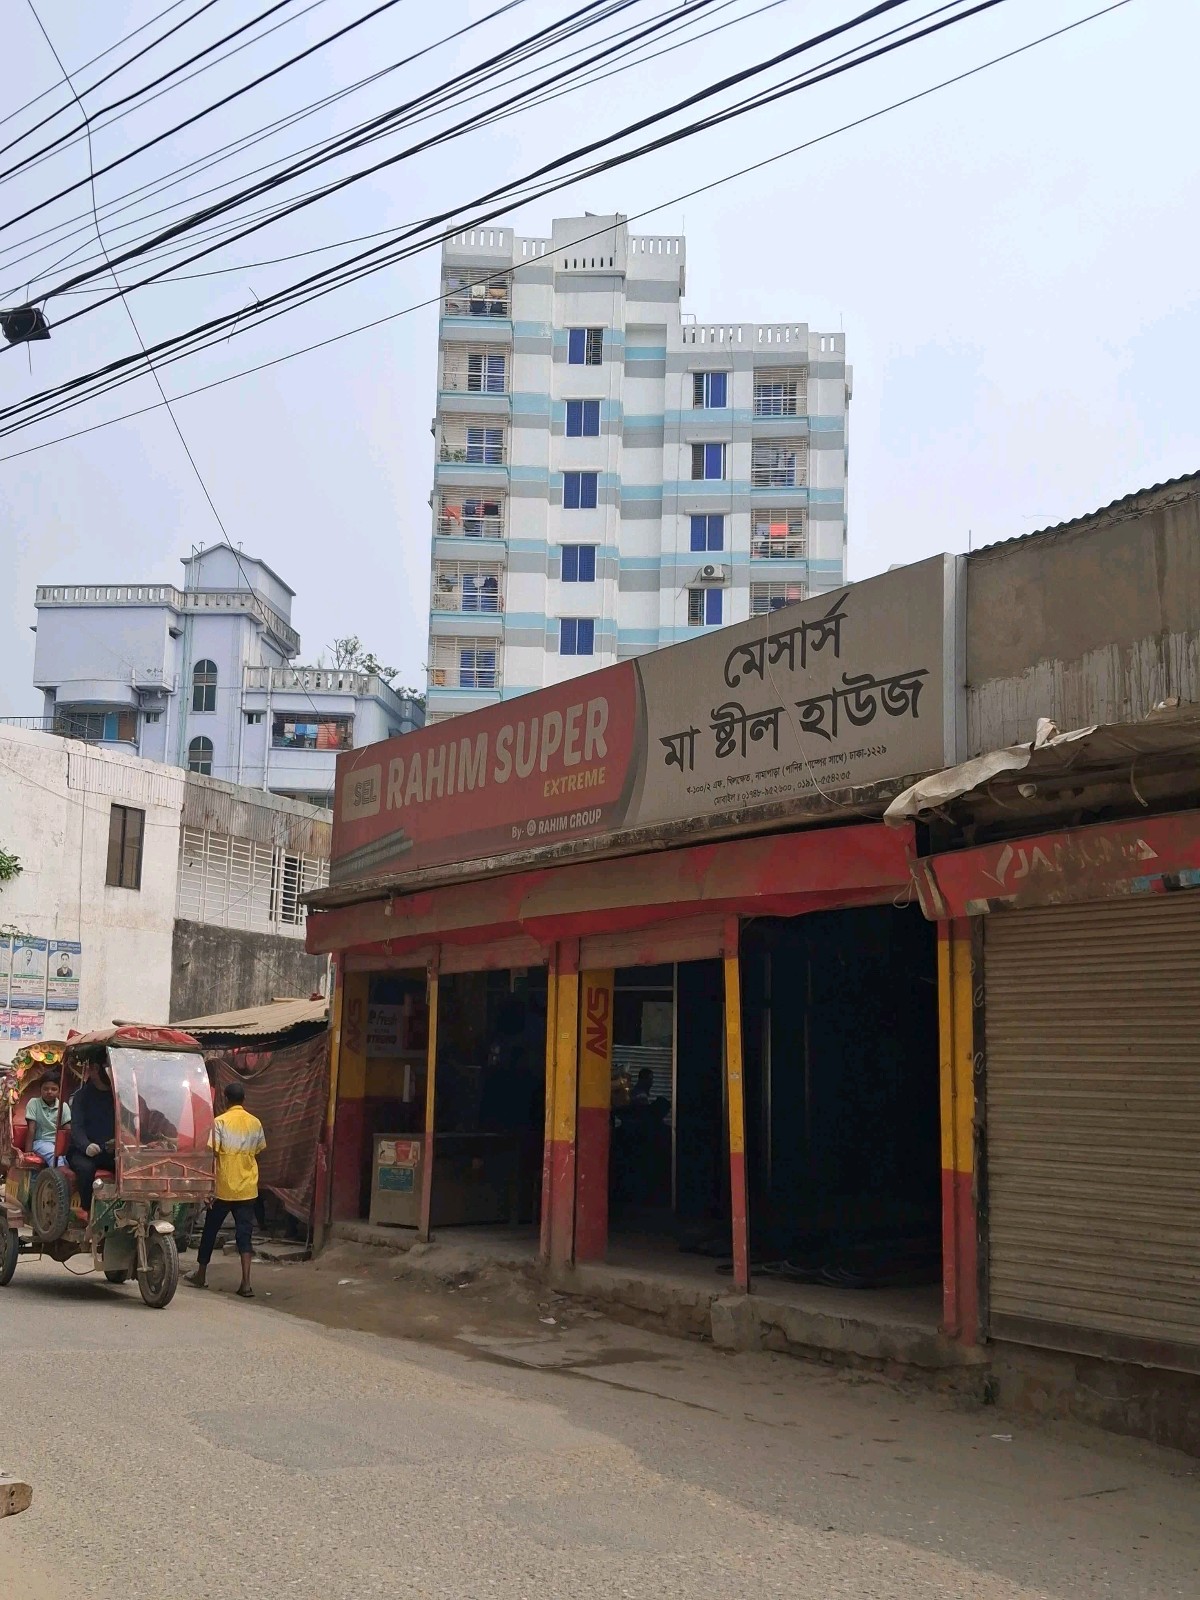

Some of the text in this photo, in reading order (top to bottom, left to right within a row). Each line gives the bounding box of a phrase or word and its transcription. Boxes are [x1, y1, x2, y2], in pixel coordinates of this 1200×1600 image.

[724, 592, 849, 688] মেসার্স
[386, 697, 608, 810] RAHIM SUPER
[659, 725, 701, 772] মা
[795, 668, 930, 742] হাউজ
[538, 815, 568, 834] RAHIM
[570, 808, 602, 828] GROUP
[543, 766, 606, 797] EXTREME
[586, 986, 609, 1059] AKS
